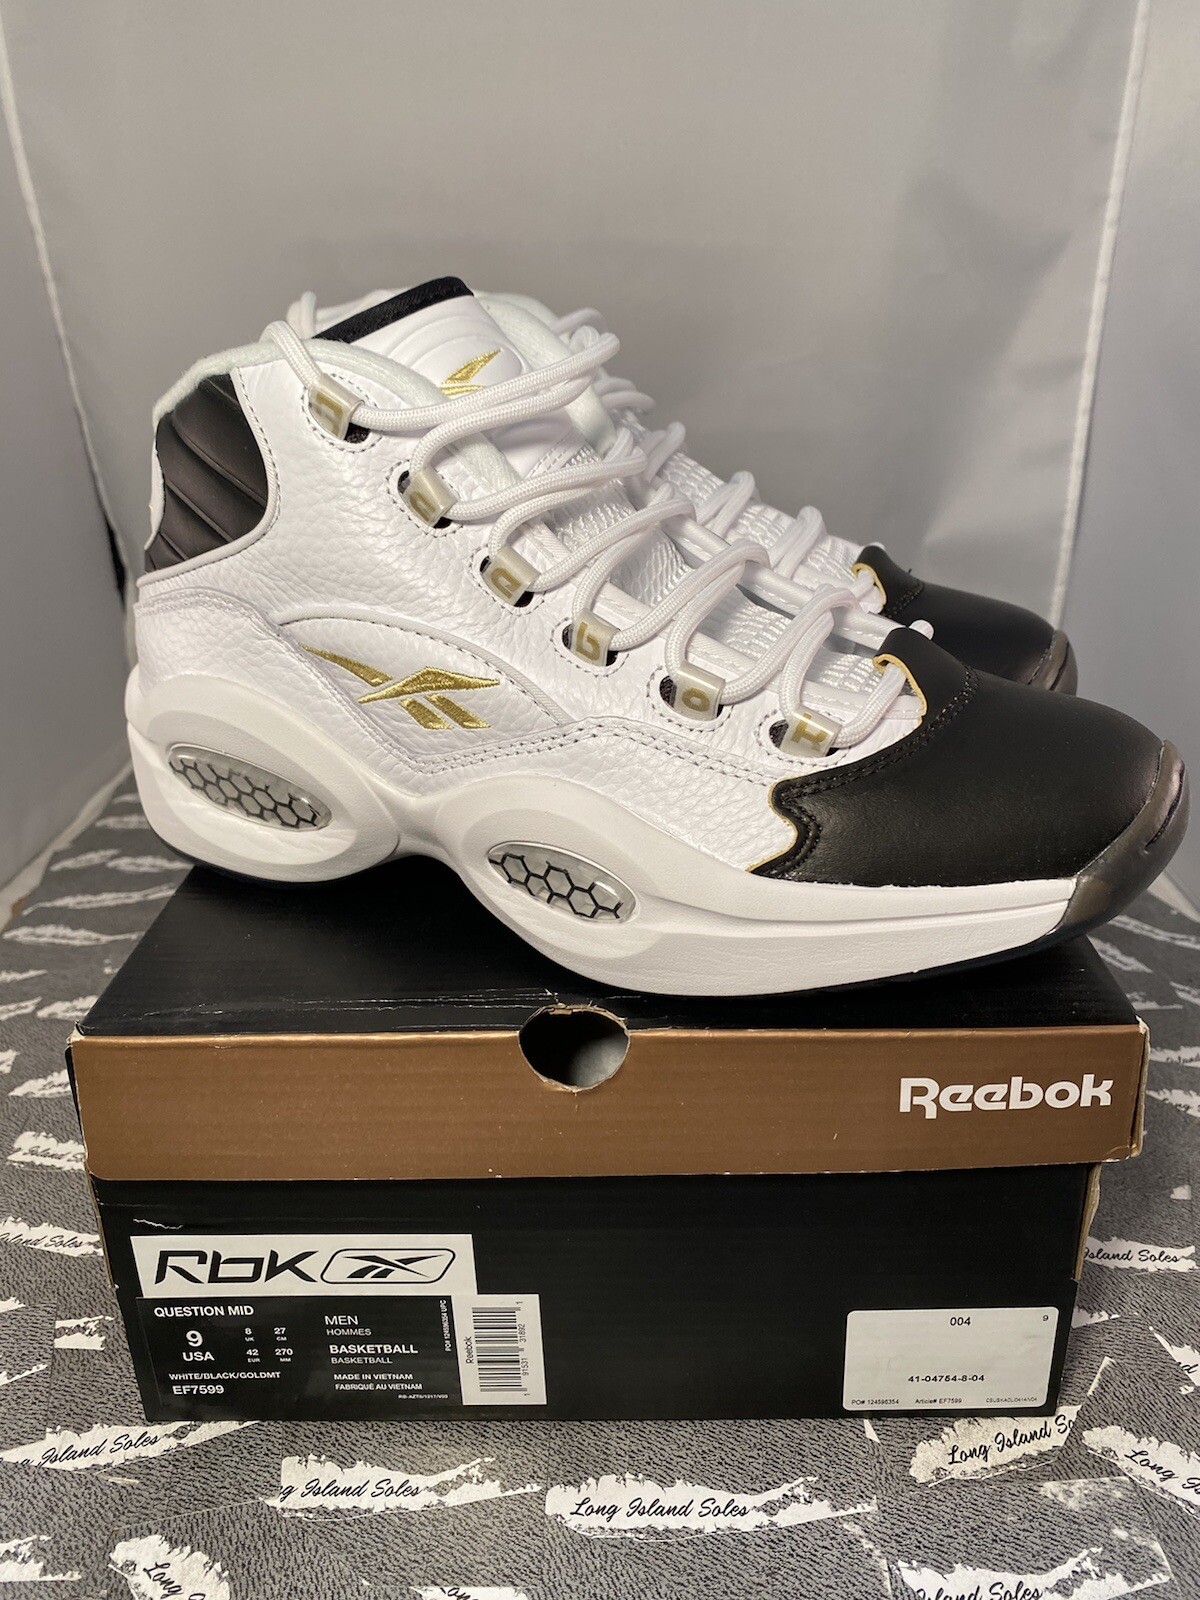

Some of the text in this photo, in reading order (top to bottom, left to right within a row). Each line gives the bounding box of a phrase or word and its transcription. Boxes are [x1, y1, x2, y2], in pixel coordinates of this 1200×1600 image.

[899, 1073, 1114, 1120] Reebok
[44, 1235, 84, 1248] Soles
[1138, 1249, 1180, 1263] Soles
[154, 1305, 254, 1318] QUESTION MID
[324, 1315, 359, 1326] MEN
[950, 1317, 971, 1326] 004
[244, 1327, 252, 1335] 8
[273, 1327, 287, 1335] 27
[326, 1328, 372, 1336] HOMMES
[185, 1330, 204, 1347] 9
[246, 1348, 259, 1356] 42
[275, 1348, 294, 1356] 270
[329, 1344, 418, 1354] BASKETBALL
[463, 1336, 475, 1365] Reebok
[182, 1351, 215, 1362] USA
[331, 1357, 393, 1365] BASKETBALL
[168, 1371, 281, 1381] WHITE/BLACK/GOLDMT
[172, 1385, 225, 1395] EF7599
[335, 1382, 375, 1391] FABRIQUÉ
[948, 1444, 991, 1465] Long
[994, 1420, 1052, 1452] Island
[37, 1430, 161, 1467] Island Soles
[1124, 1450, 1179, 1482] Long
[300, 1478, 371, 1498] Island
[370, 1478, 423, 1498] Soles
[569, 1496, 751, 1523] Long Island Soles
[143, 1561, 184, 1599] Long
